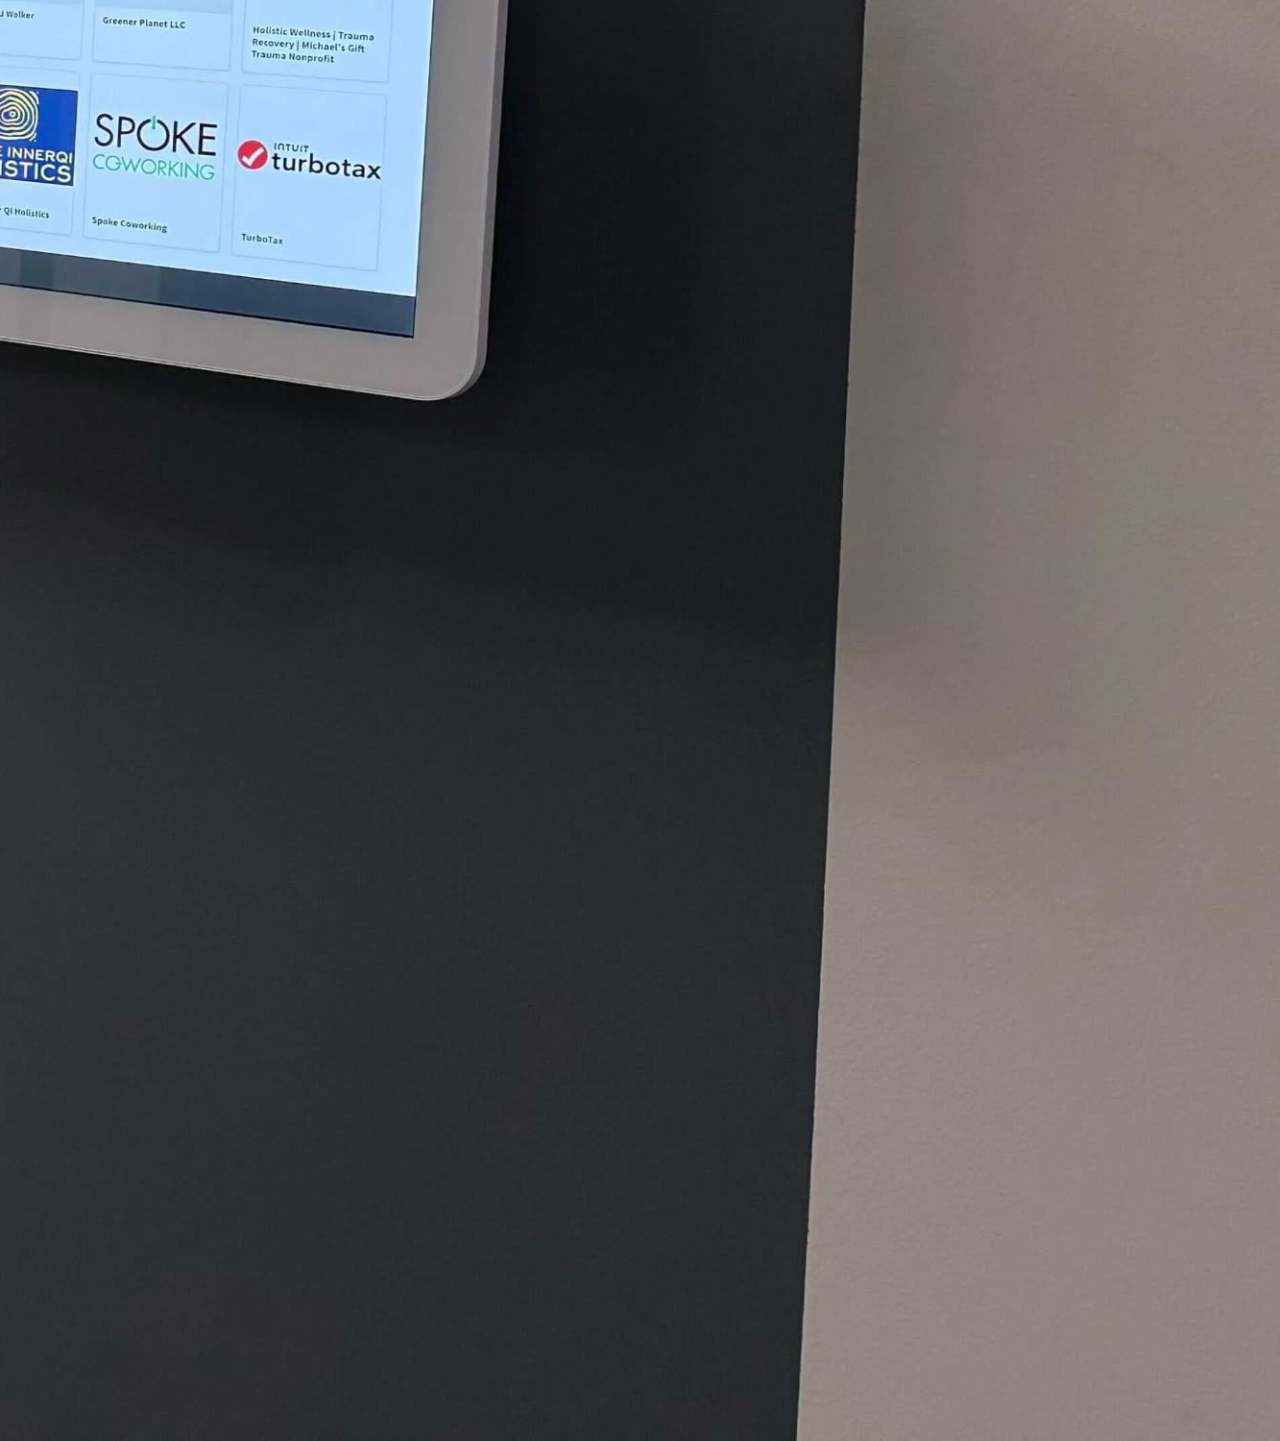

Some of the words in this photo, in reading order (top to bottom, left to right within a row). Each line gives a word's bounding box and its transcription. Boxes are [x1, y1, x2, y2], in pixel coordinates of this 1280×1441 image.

[102, 16, 137, 26] Greener
[139, 18, 168, 28] Planet
[170, 21, 186, 29] LLC
[253, 26, 288, 36] Holistic
[289, 27, 331, 38] Wellness
[338, 31, 375, 41] Trauma
[252, 38, 295, 50] Recovery
[301, 41, 346, 52] Michael's
[348, 44, 365, 54] Gift
[251, 50, 287, 60] Trauma
[288, 52, 335, 63] Nonprofit
[94, 113, 218, 157] SPOKE
[7, 146, 73, 165] INNERQI
[92, 153, 215, 181] COWORKING
[272, 153, 381, 180] turbotax
[4, 207, 13, 216] Qi
[14, 208, 50, 219] Holistics
[92, 216, 118, 227] Spoke
[120, 219, 168, 234] Coworking
[241, 233, 283, 245] TurboTax
